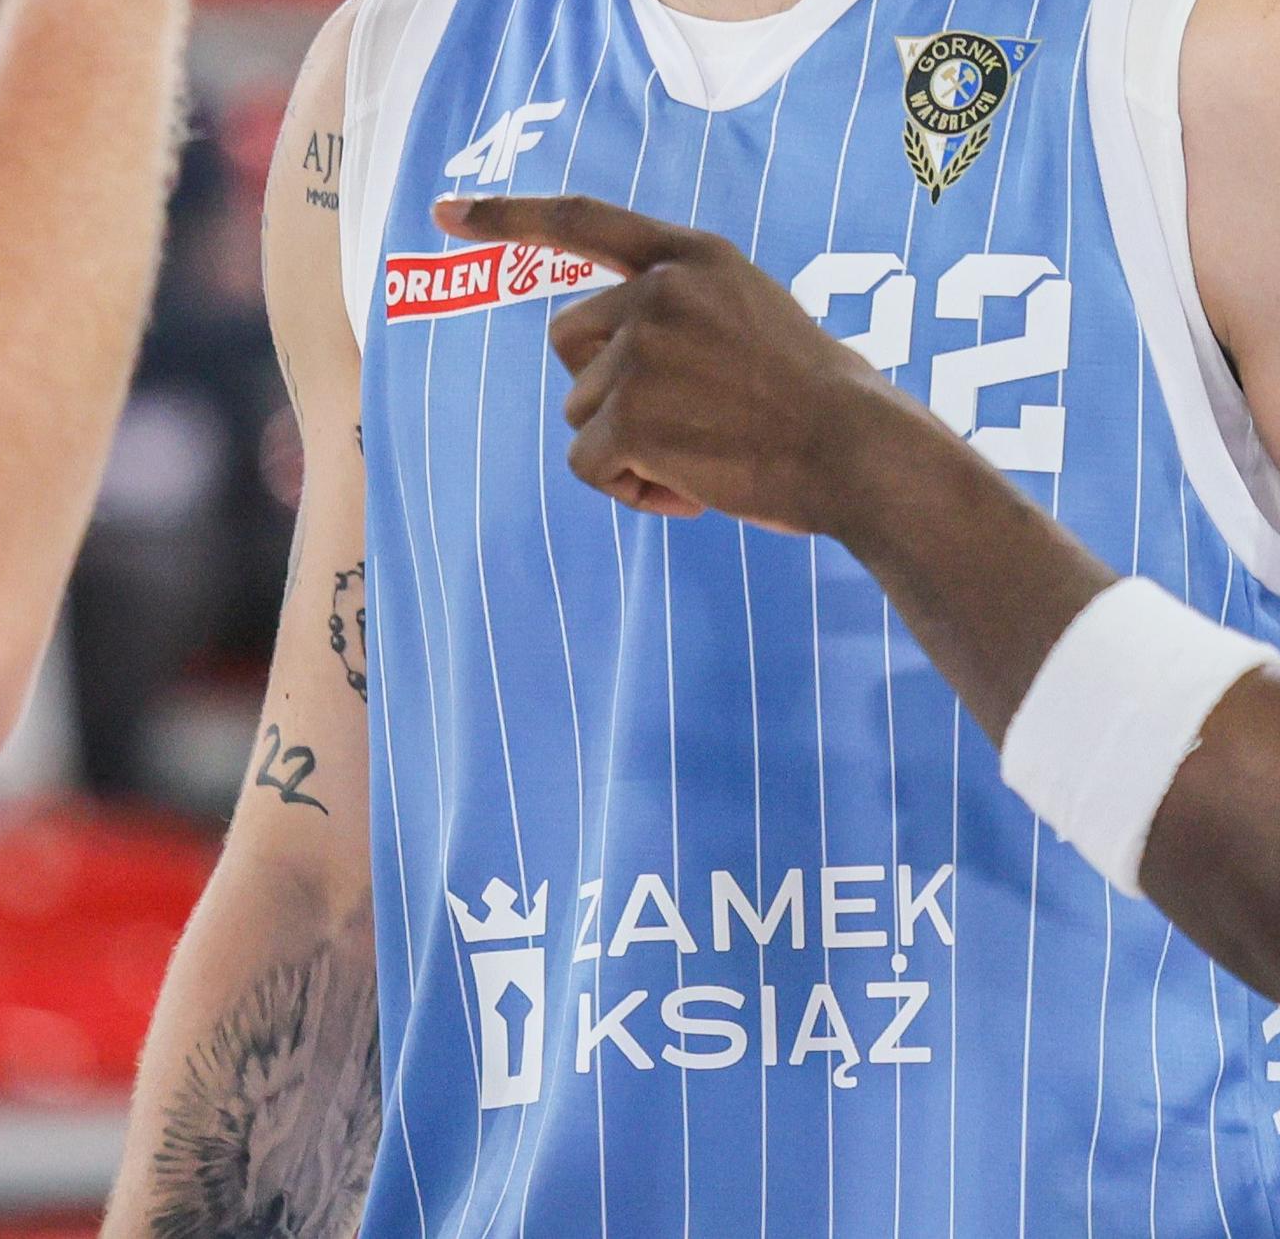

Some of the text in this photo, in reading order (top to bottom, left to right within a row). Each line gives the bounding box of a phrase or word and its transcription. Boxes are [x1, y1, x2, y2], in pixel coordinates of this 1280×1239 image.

[444, 99, 566, 184] 4F
[386, 259, 492, 306] ORLEN
[550, 260, 593, 287] Liga
[256, 723, 329, 816] 22
[572, 863, 955, 965] ZAMEK
[575, 953, 932, 1089] KSIĄŻ
